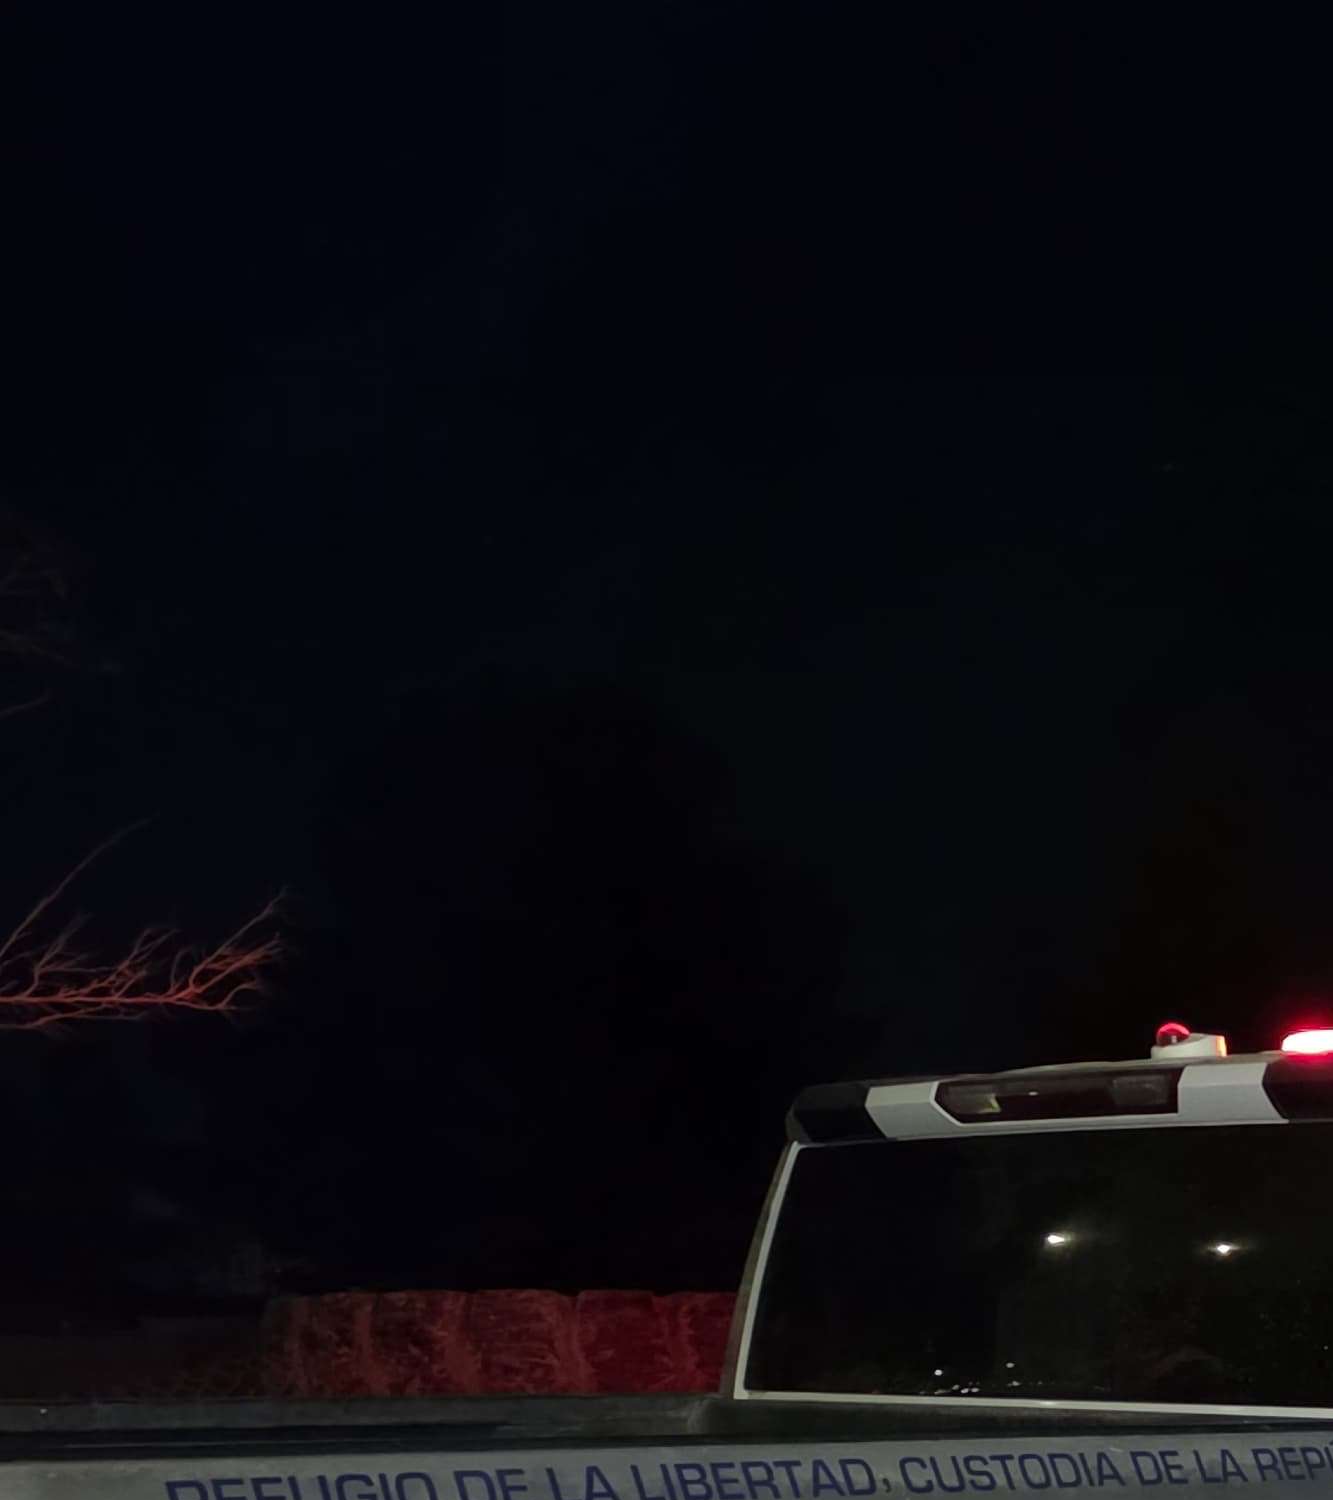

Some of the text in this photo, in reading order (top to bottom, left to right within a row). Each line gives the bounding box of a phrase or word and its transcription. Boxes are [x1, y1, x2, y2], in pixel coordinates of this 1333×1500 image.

[900, 1450, 1125, 1496] CUSTODIA
[1130, 1448, 1188, 1487] DE
[1196, 1447, 1246, 1484] LA
